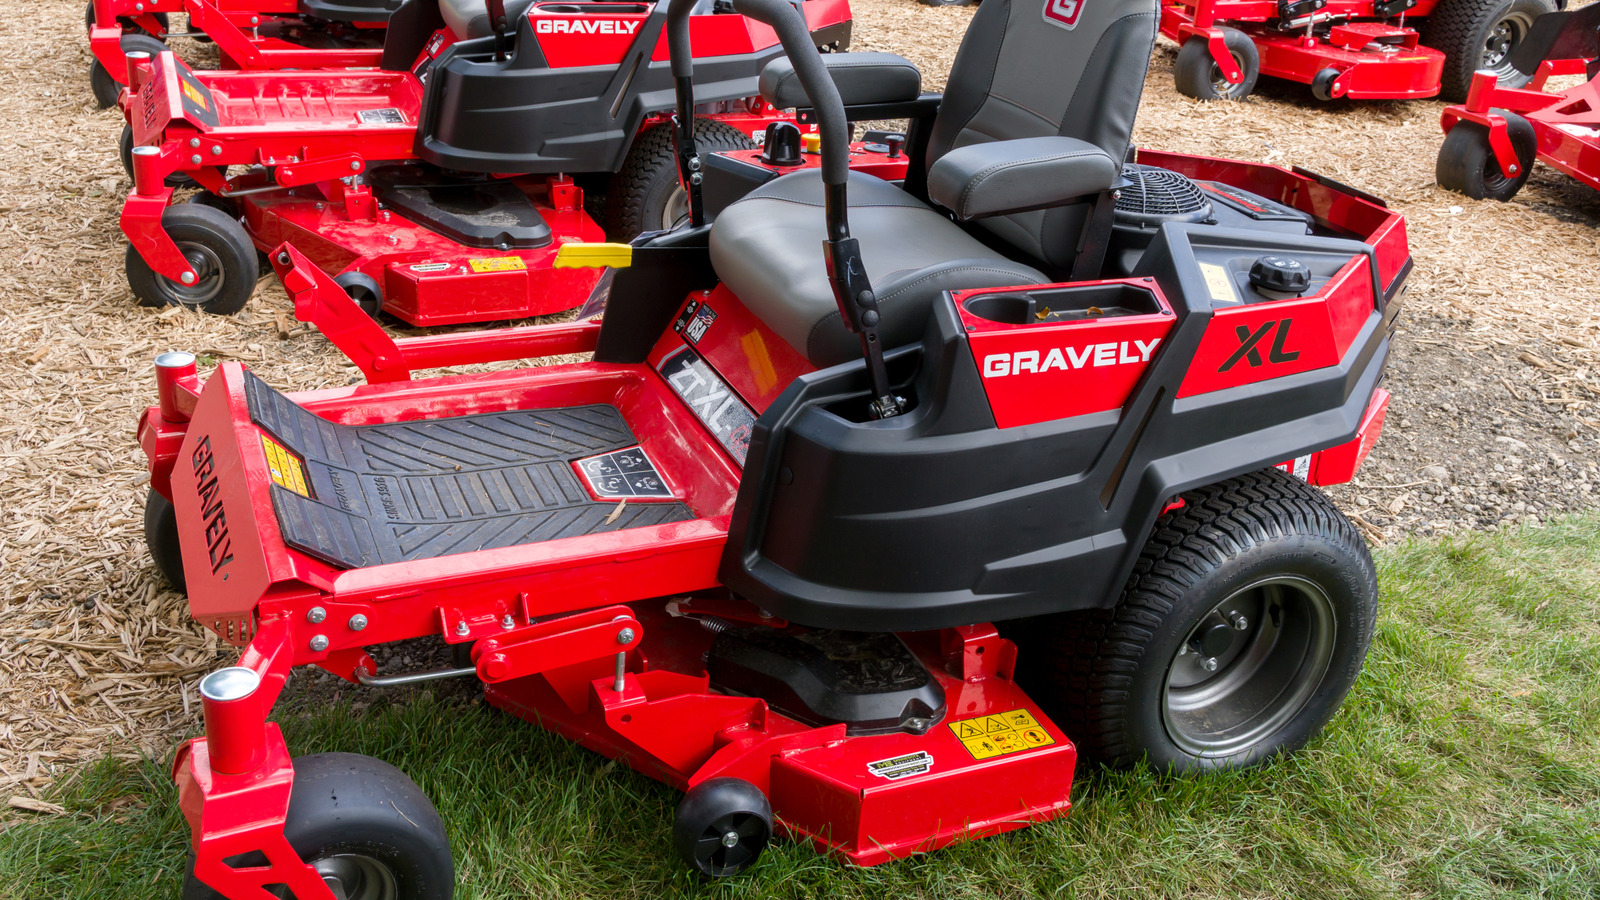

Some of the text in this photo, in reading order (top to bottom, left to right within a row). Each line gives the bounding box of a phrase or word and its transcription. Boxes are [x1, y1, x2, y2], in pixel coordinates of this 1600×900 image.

[536, 19, 640, 34] GRAVELY
[685, 316, 709, 342] USA
[1217, 318, 1300, 373] XL
[983, 337, 1162, 379] GRAVELY
[191, 434, 235, 576] GRAVELY
[379, 494, 400, 519] SINCE
